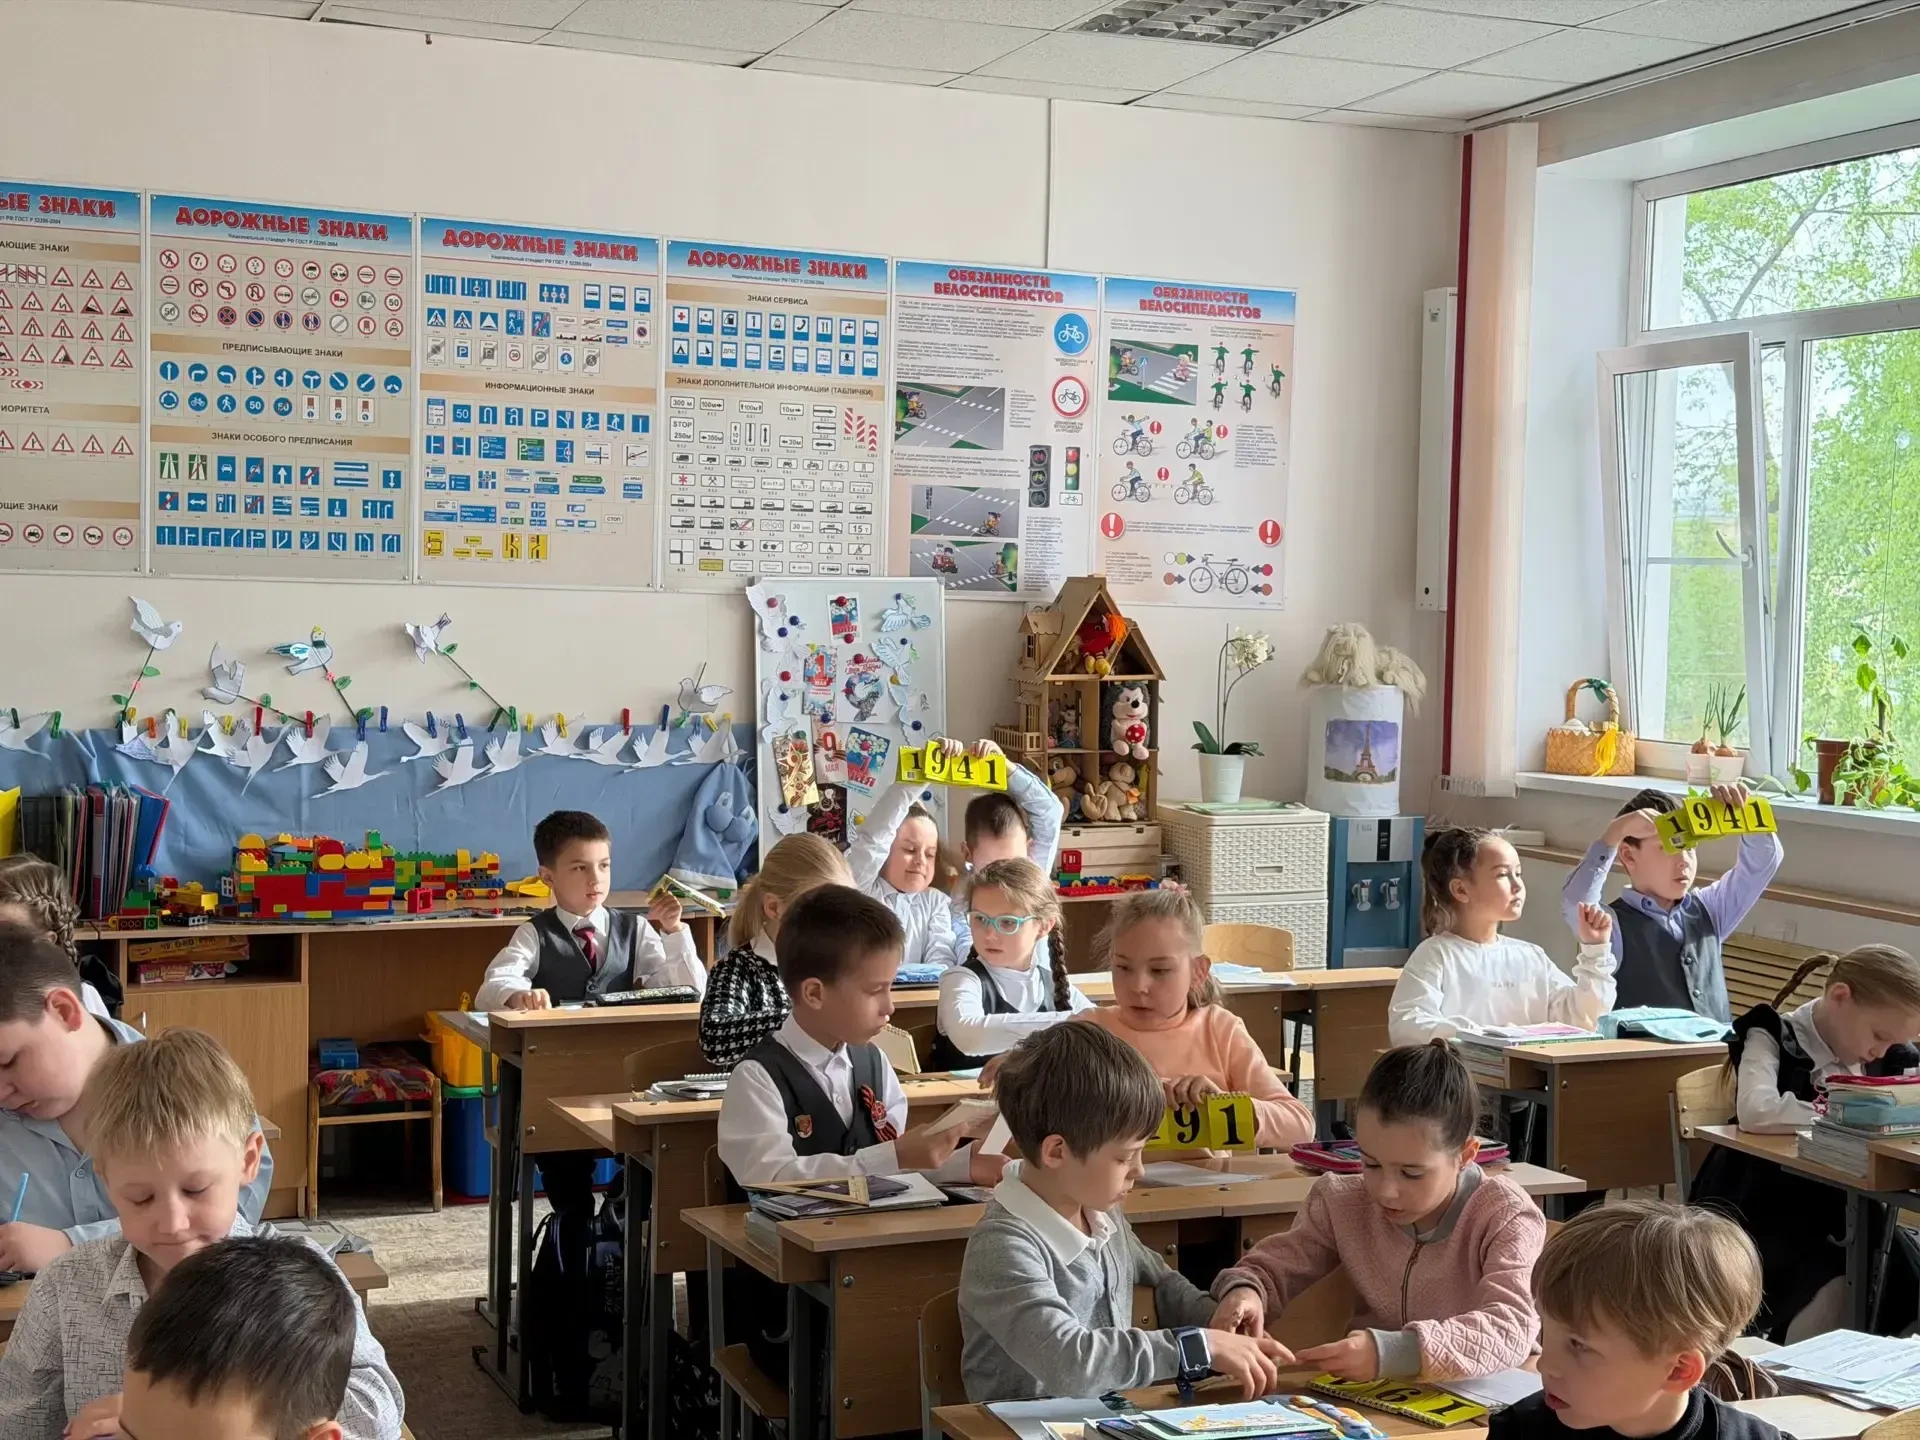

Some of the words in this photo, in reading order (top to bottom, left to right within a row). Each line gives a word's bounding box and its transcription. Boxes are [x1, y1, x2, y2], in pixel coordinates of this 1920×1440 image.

[39, 195, 116, 218] ЗНАКИ
[176, 207, 309, 235] ДОРОЖНЫЕ
[317, 219, 388, 241] ЗНАКИ
[39, 243, 70, 252] ЗНАКИ
[442, 229, 566, 255] ДОРОЖНЫЕ
[573, 240, 638, 261] ЗНАКИ
[687, 249, 801, 274] ДОРОЖНЫЕ
[808, 260, 868, 280] ЗНАКИ
[948, 269, 1051, 289] ОБЯЗАННОСТИ
[747, 294, 772, 303] ЗНАКИ
[774, 296, 809, 306] СЕРВИСА
[934, 281, 1064, 303] ВЕЛОСИПЕДИСТОВ
[1153, 286, 1248, 304] ОБЯЗАННОСТИ
[1139, 299, 1261, 319] ВЕЛОСИПЕДИСТОВ
[222, 343, 312, 357] ПРЕДПИСЫВАЮЩИЕ
[315, 348, 343, 358] ЗНАКИ
[485, 382, 567, 394] ИНФОРМАЦИОННЫЕ
[568, 386, 595, 395] ЗНАКИ
[676, 377, 701, 386] ЗНАКИ
[703, 379, 775, 391] ДОПОЛНИТЕЛЬНОЙ
[777, 383, 830, 393] ИНФОРМАЦИИ
[831, 386, 874, 397] (ТАБЛИЧКИ)
[250, 401, 261, 410] 50
[456, 409, 469, 419] 50
[212, 432, 241, 440] ЗНАКИ
[243, 433, 286, 443] ОСОБОГО
[288, 436, 353, 446] ПРЕДПИСАНИЯ
[28, 503, 58, 511] ЗНАКИ
[853, 525, 862, 533] 15
[815, 654, 825, 679] 1
[822, 732, 836, 762] 9
